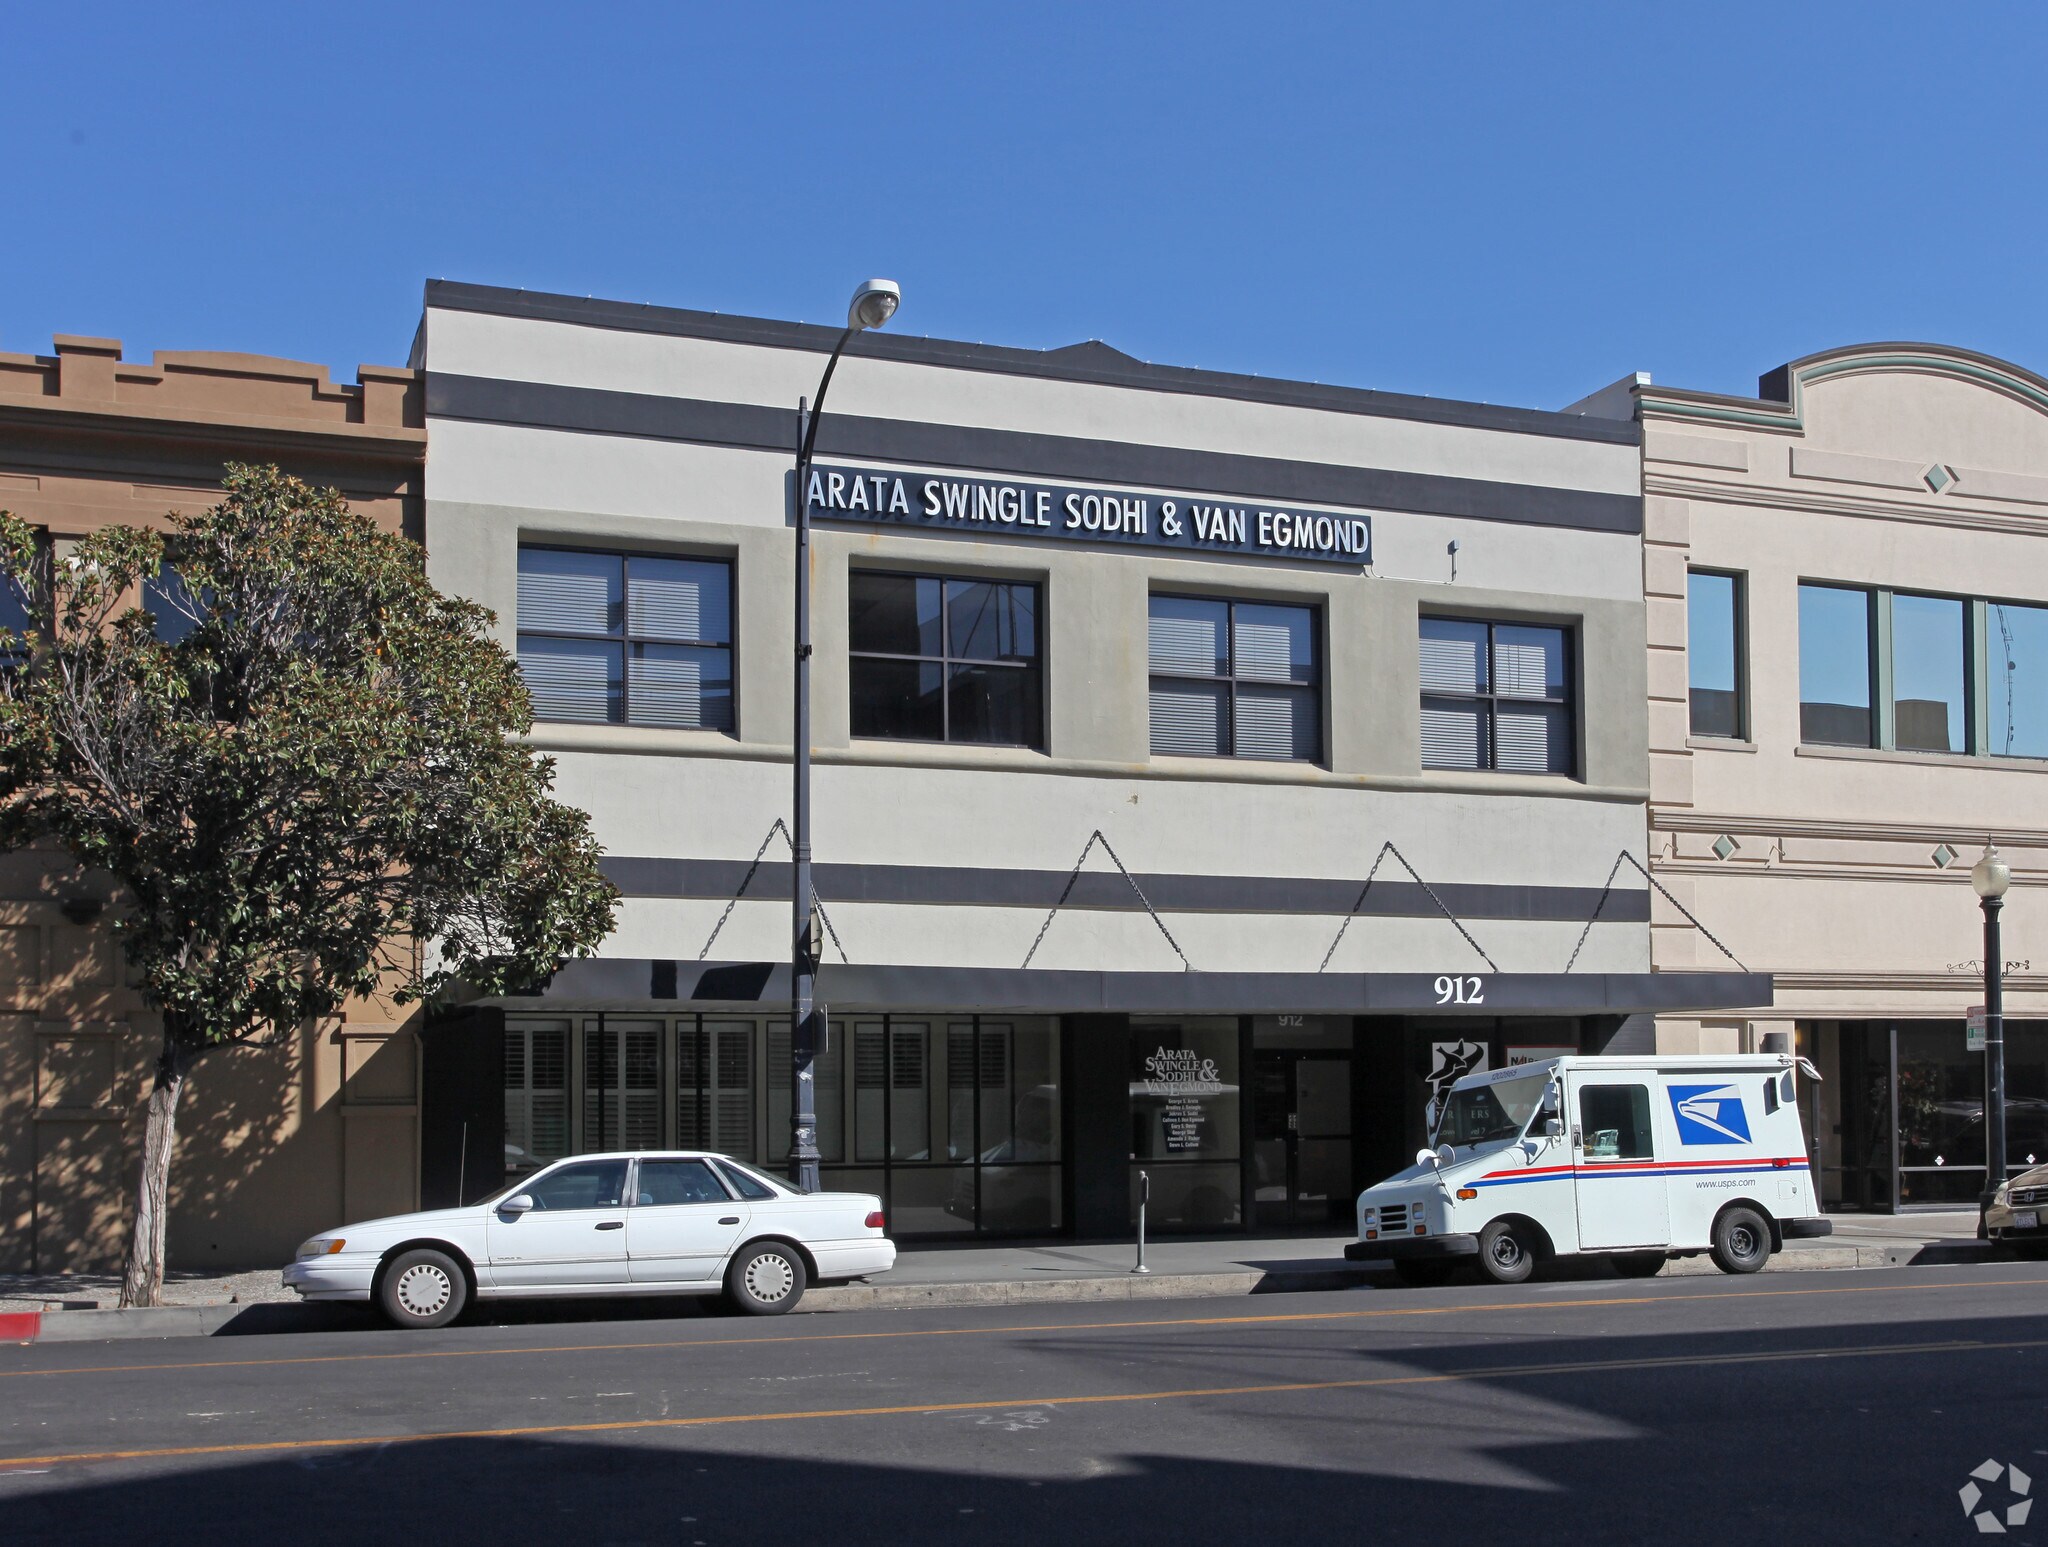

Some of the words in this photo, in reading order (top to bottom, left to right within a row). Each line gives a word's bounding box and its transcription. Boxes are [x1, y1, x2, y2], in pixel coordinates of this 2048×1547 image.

[807, 470, 909, 515] ARATA
[923, 479, 1051, 527] SWINGLE
[1065, 493, 1148, 535] SODHI
[1161, 501, 1183, 536] &
[1192, 505, 1246, 544] VAN
[1258, 511, 1369, 555] EGMOND
[1434, 976, 1484, 1004] 912
[1278, 1015, 1304, 1026] 912
[1197, 1059, 1221, 1081] &
[1695, 1179, 1756, 1189] www.usps.com
